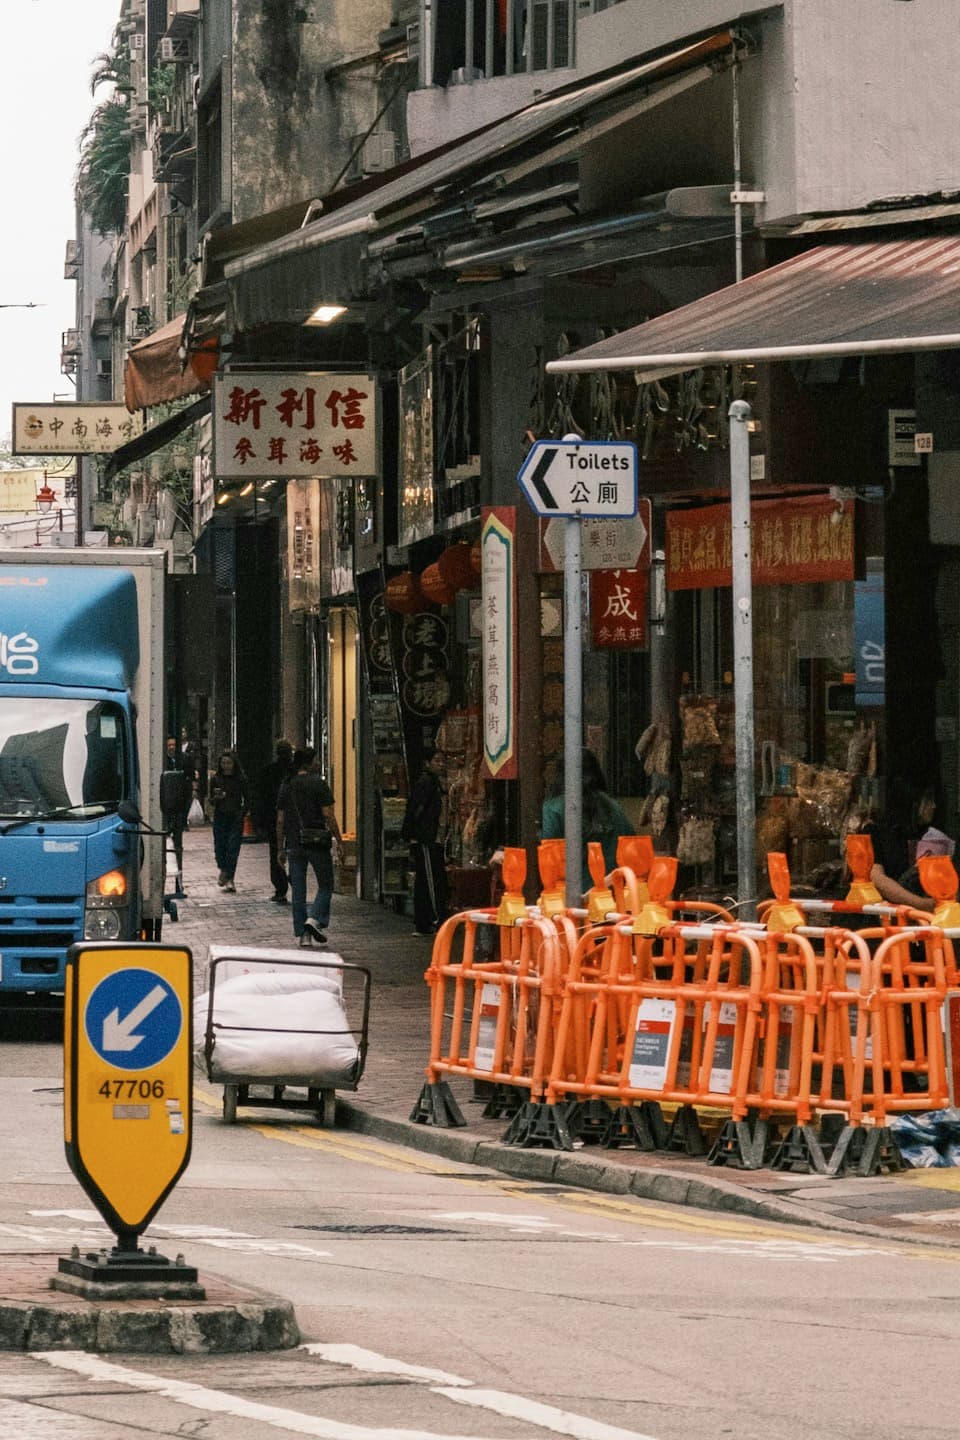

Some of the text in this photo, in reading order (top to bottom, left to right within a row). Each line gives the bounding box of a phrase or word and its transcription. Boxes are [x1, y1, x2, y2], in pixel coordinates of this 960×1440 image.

[223, 386, 369, 430] 新利信
[233, 437, 359, 466] 參茸海味
[917, 437, 931, 449] 128
[566, 453, 630, 471] Toilets
[569, 481, 619, 504] 公廁
[98, 1079, 165, 1099] 47706
